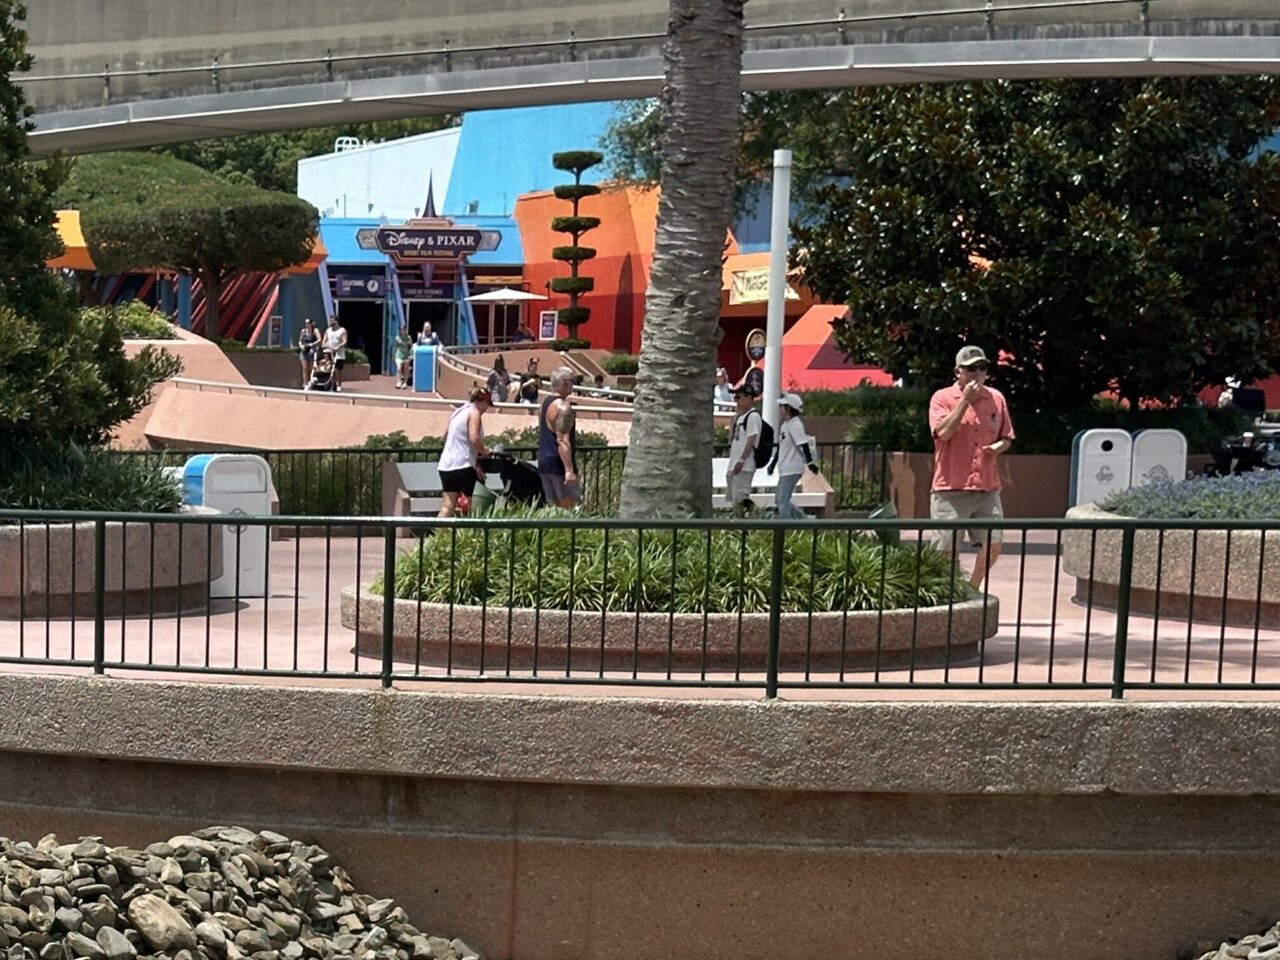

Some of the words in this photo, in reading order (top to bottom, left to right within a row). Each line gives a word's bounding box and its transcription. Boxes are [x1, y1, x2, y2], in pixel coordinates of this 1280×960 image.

[384, 231, 426, 249] Disney
[427, 235, 434, 246] &
[436, 235, 475, 246] PIXAR
[420, 249, 432, 257] FILM
